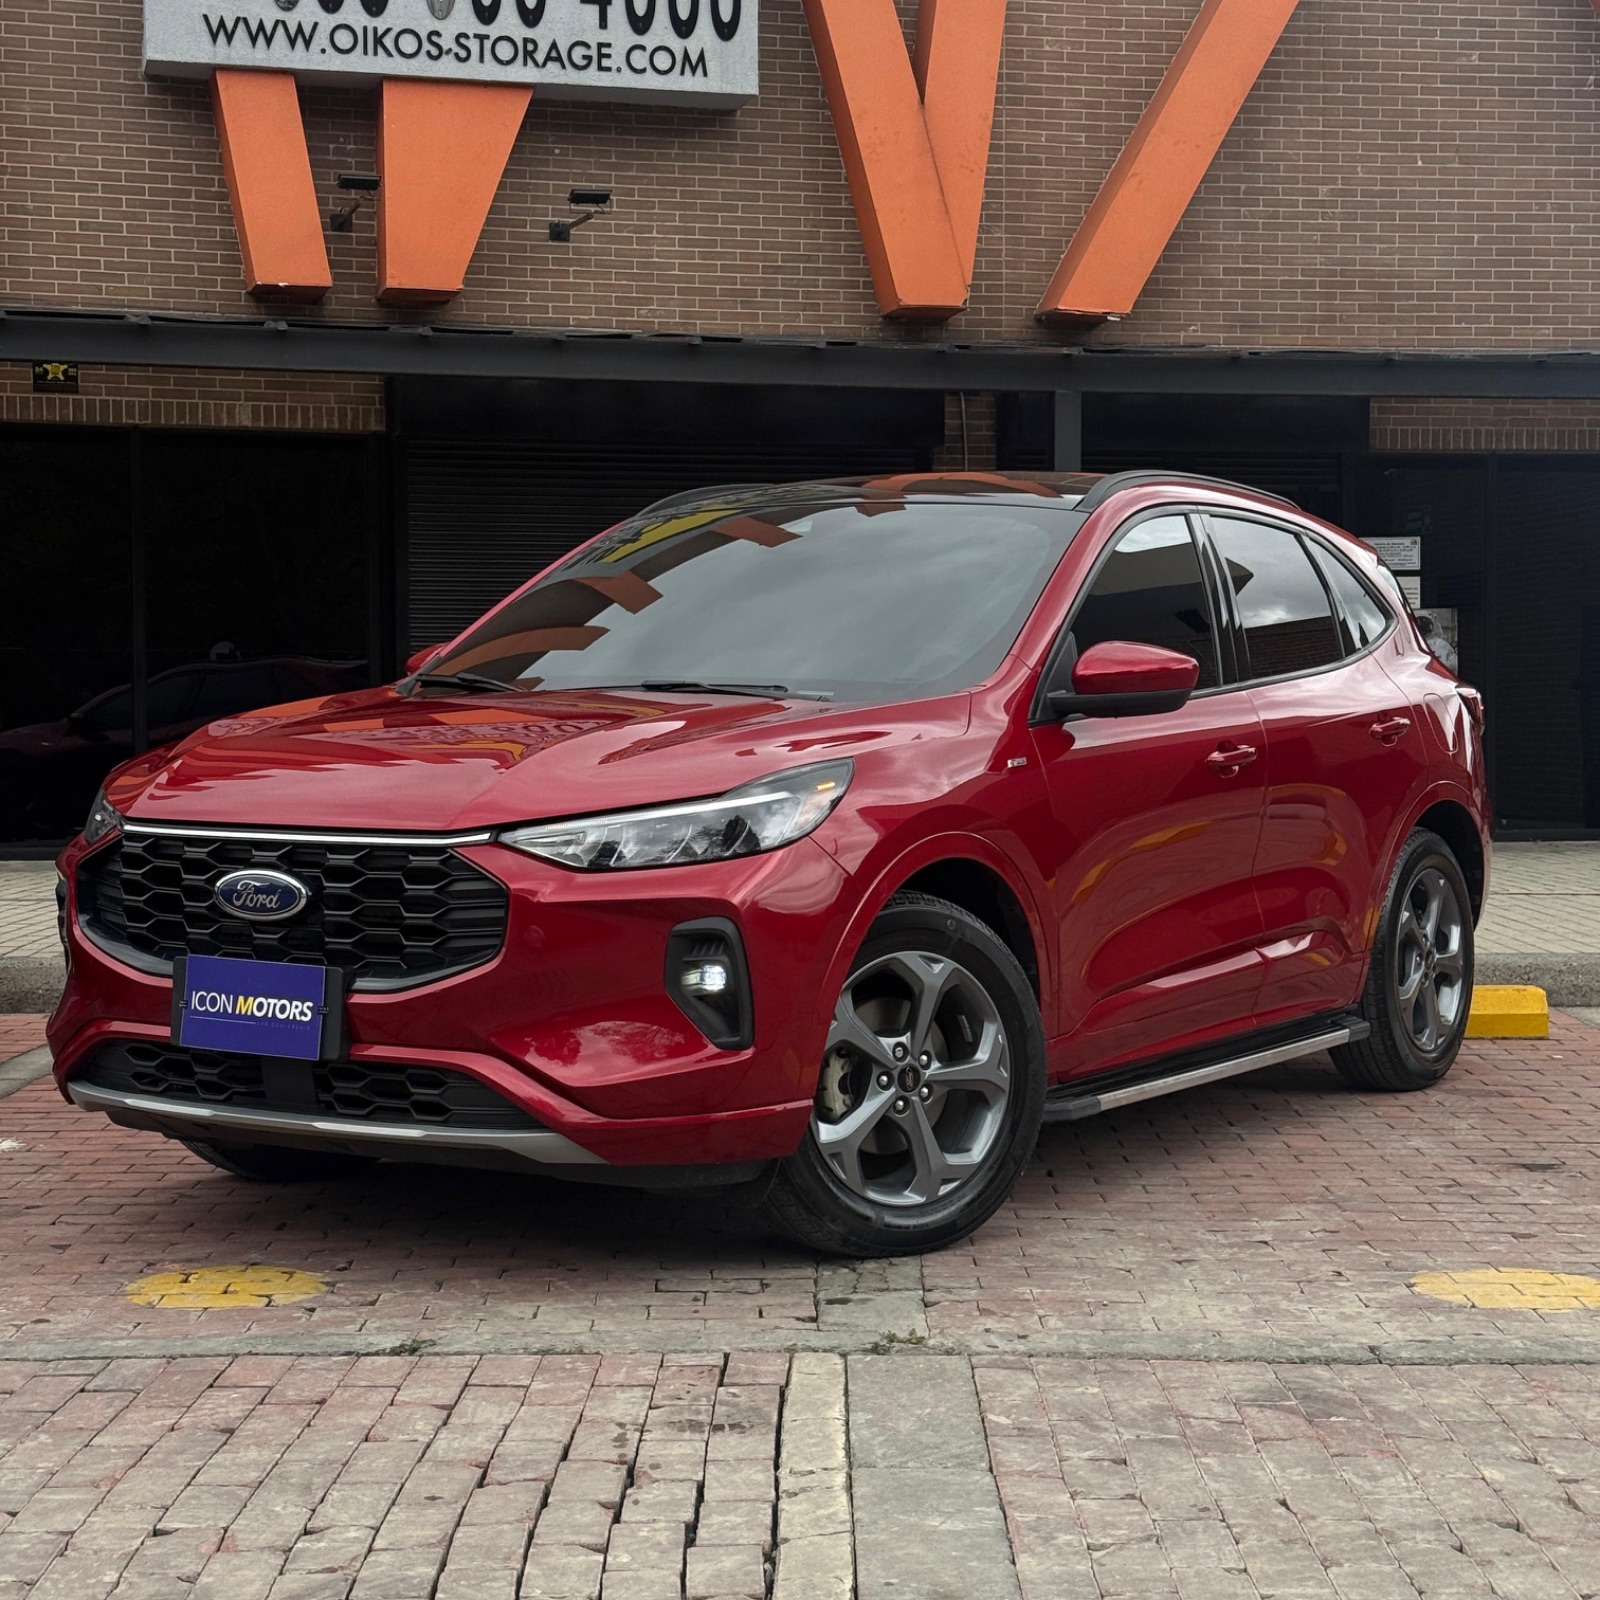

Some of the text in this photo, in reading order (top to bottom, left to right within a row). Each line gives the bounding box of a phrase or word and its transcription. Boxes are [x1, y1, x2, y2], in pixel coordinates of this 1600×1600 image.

[202, 13, 709, 78] WWW.OIKOS-STORAGE.COM
[233, 879, 281, 909] Ford
[191, 990, 314, 1022] ICON MOTORS
